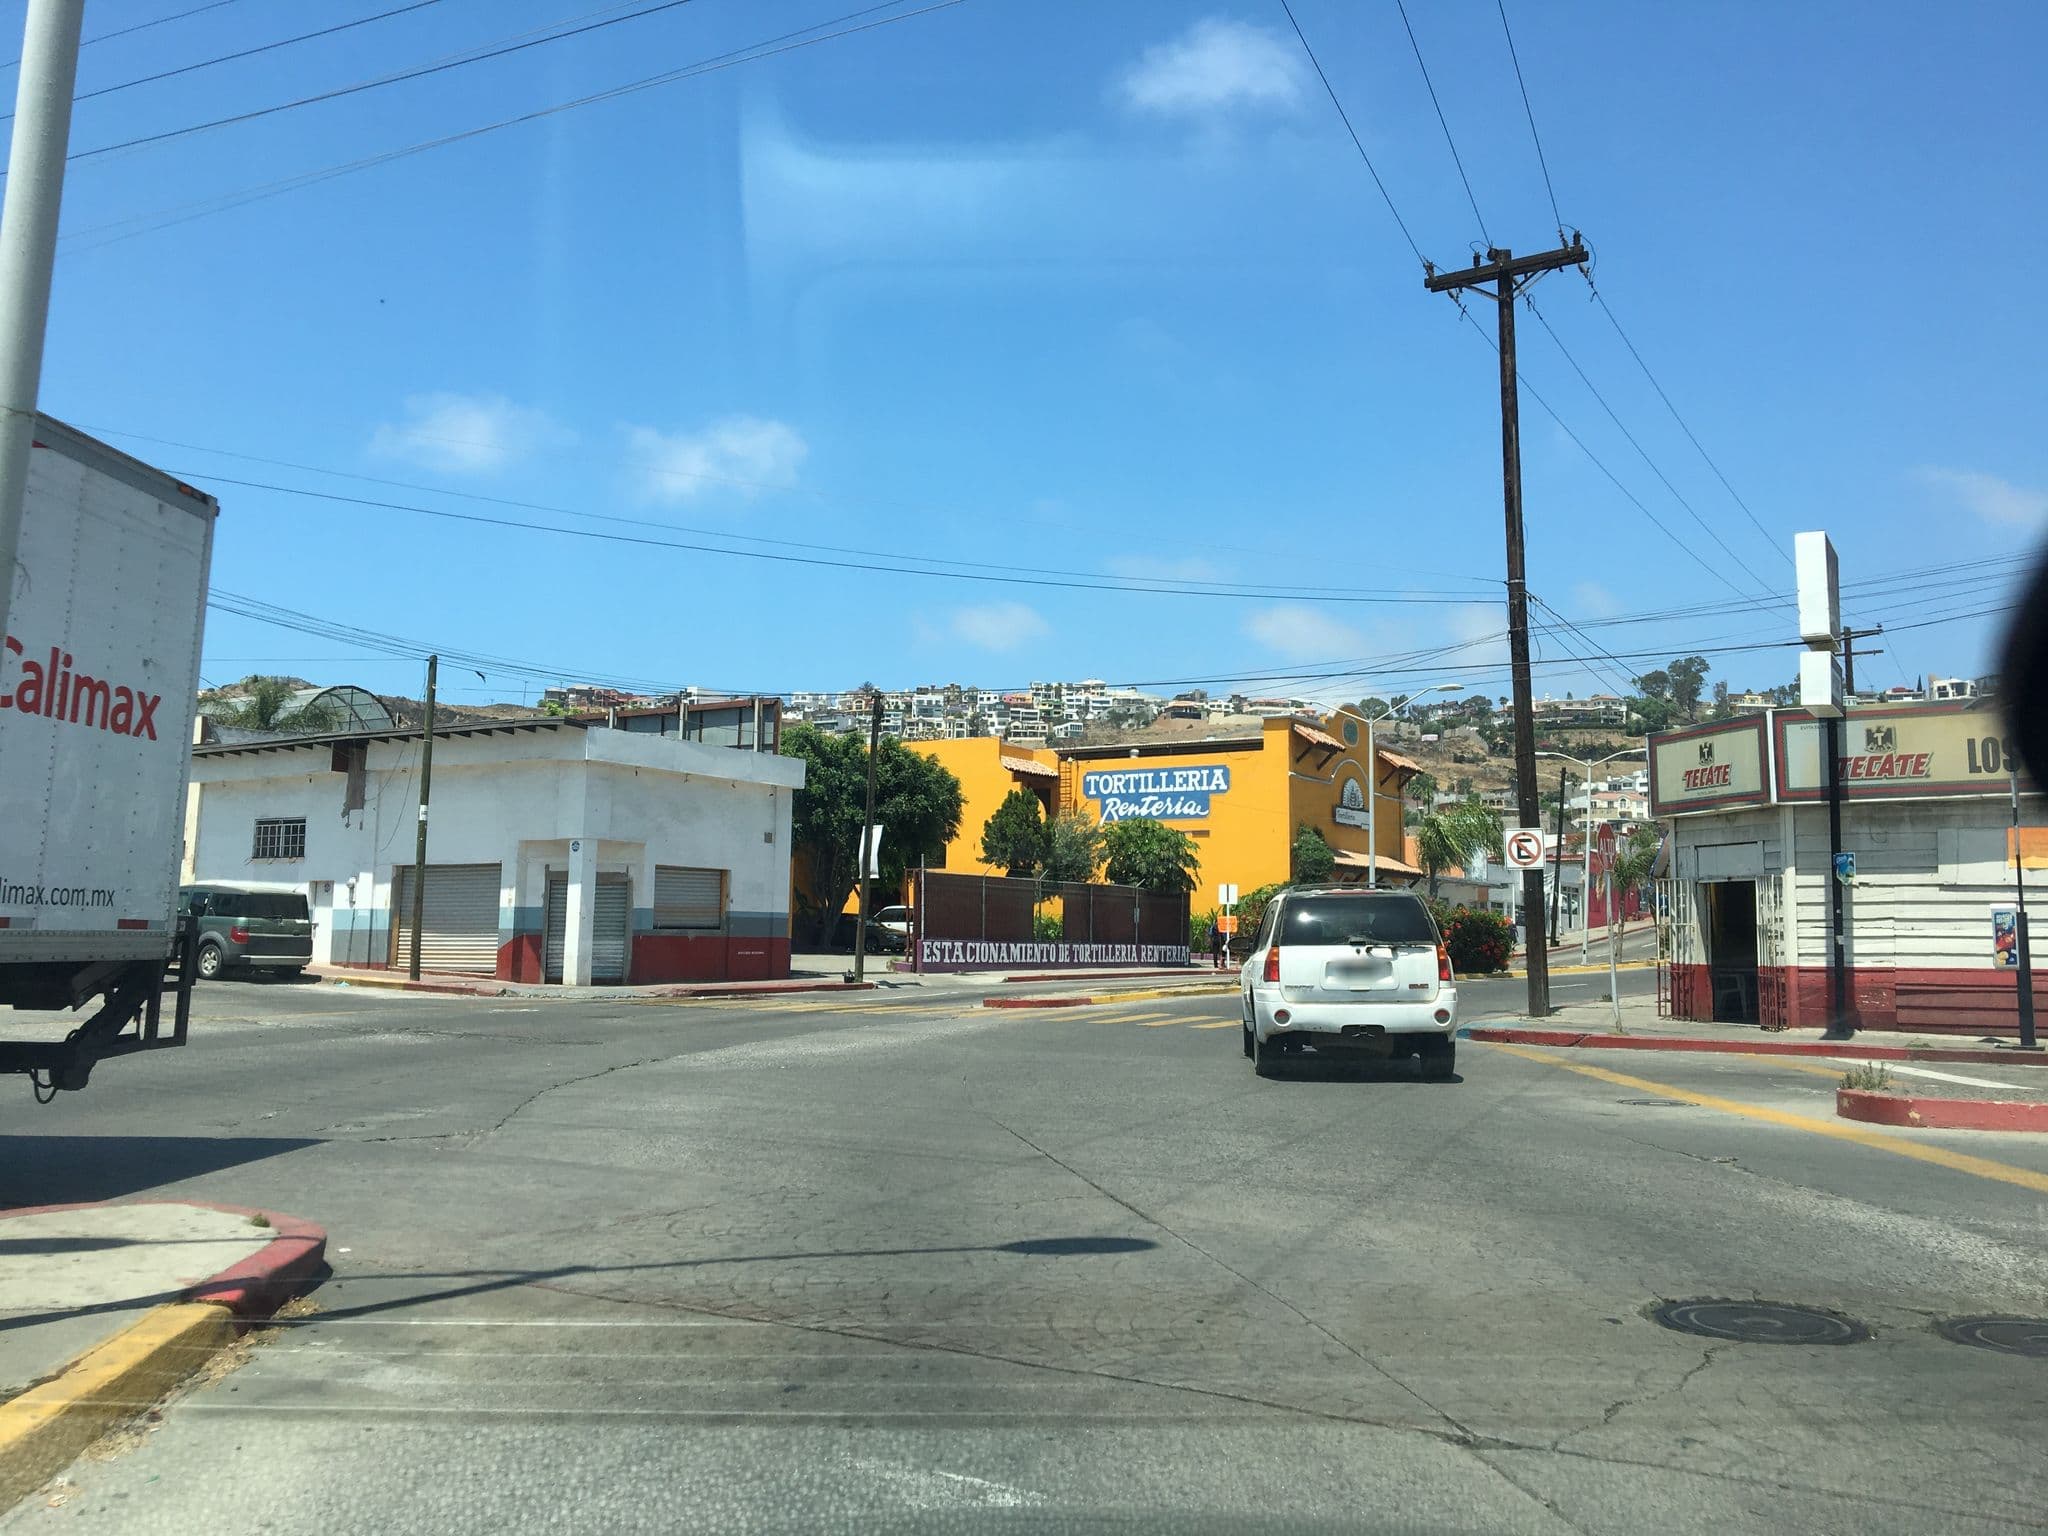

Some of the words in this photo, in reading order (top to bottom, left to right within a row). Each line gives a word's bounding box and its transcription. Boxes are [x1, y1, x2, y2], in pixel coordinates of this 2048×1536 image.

[1838, 753, 1931, 780] TECATE
[1966, 736, 2021, 774] LOS
[1086, 768, 1228, 795] TORTILLERIA
[1684, 764, 1731, 790] TECATE
[1599, 837, 1616, 856] ALTO
[922, 941, 1056, 963] ESTACIONAMIENTO
[1058, 943, 1070, 962] DE
[1072, 944, 1138, 963] TORTILLERIA
[1141, 945, 1186, 963] RENTERIA
